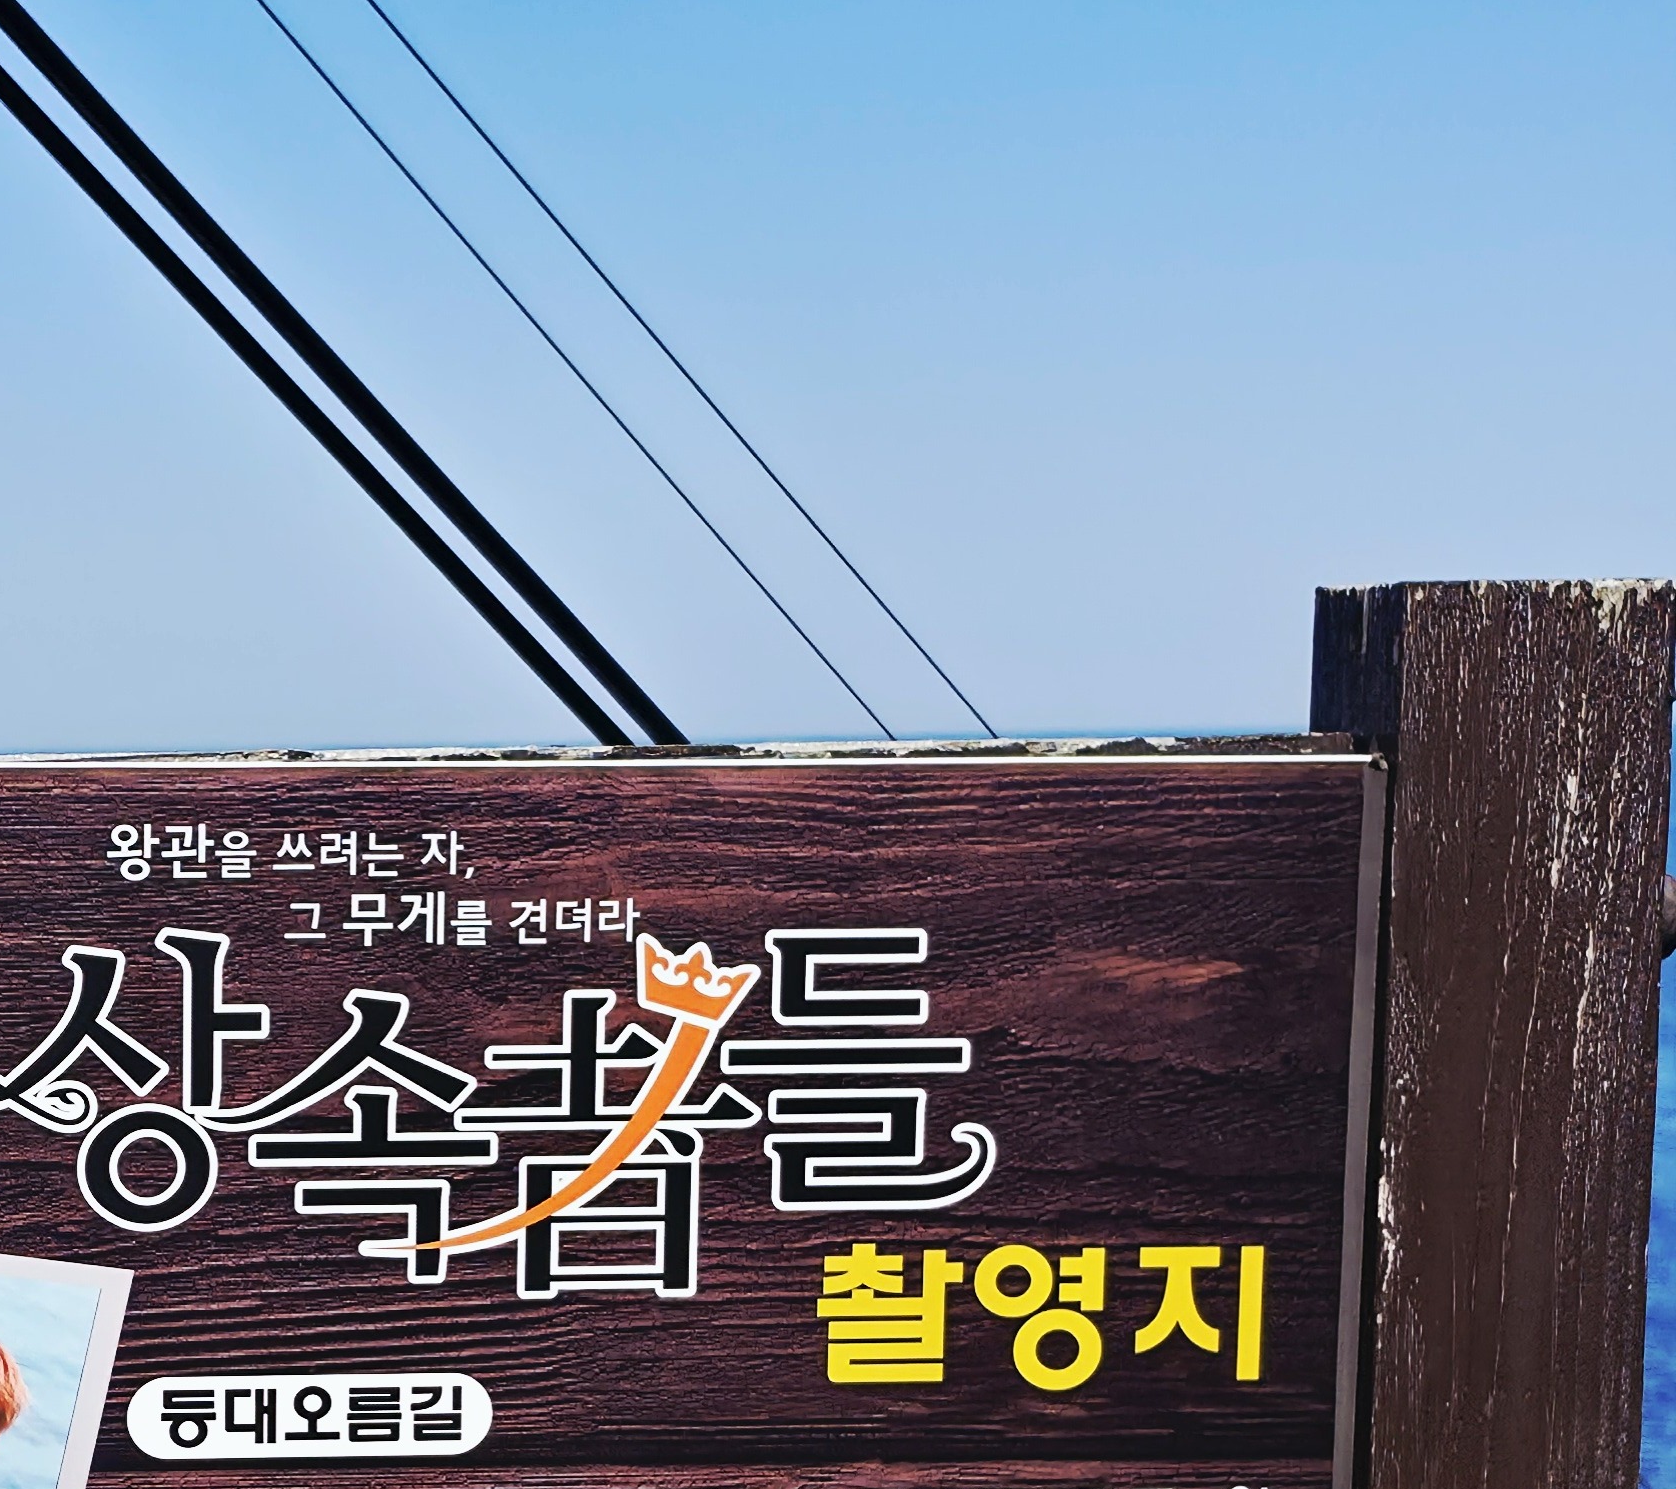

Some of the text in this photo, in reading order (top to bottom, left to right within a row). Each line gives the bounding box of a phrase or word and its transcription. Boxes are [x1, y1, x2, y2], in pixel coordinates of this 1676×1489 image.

[107, 824, 257, 881] 왕관을
[273, 831, 404, 876] 쓰려는
[284, 891, 641, 946] 그 무게를 견뎌라
[817, 1244, 1264, 1390] 촬영지
[162, 1386, 463, 1448] 등대오름길
